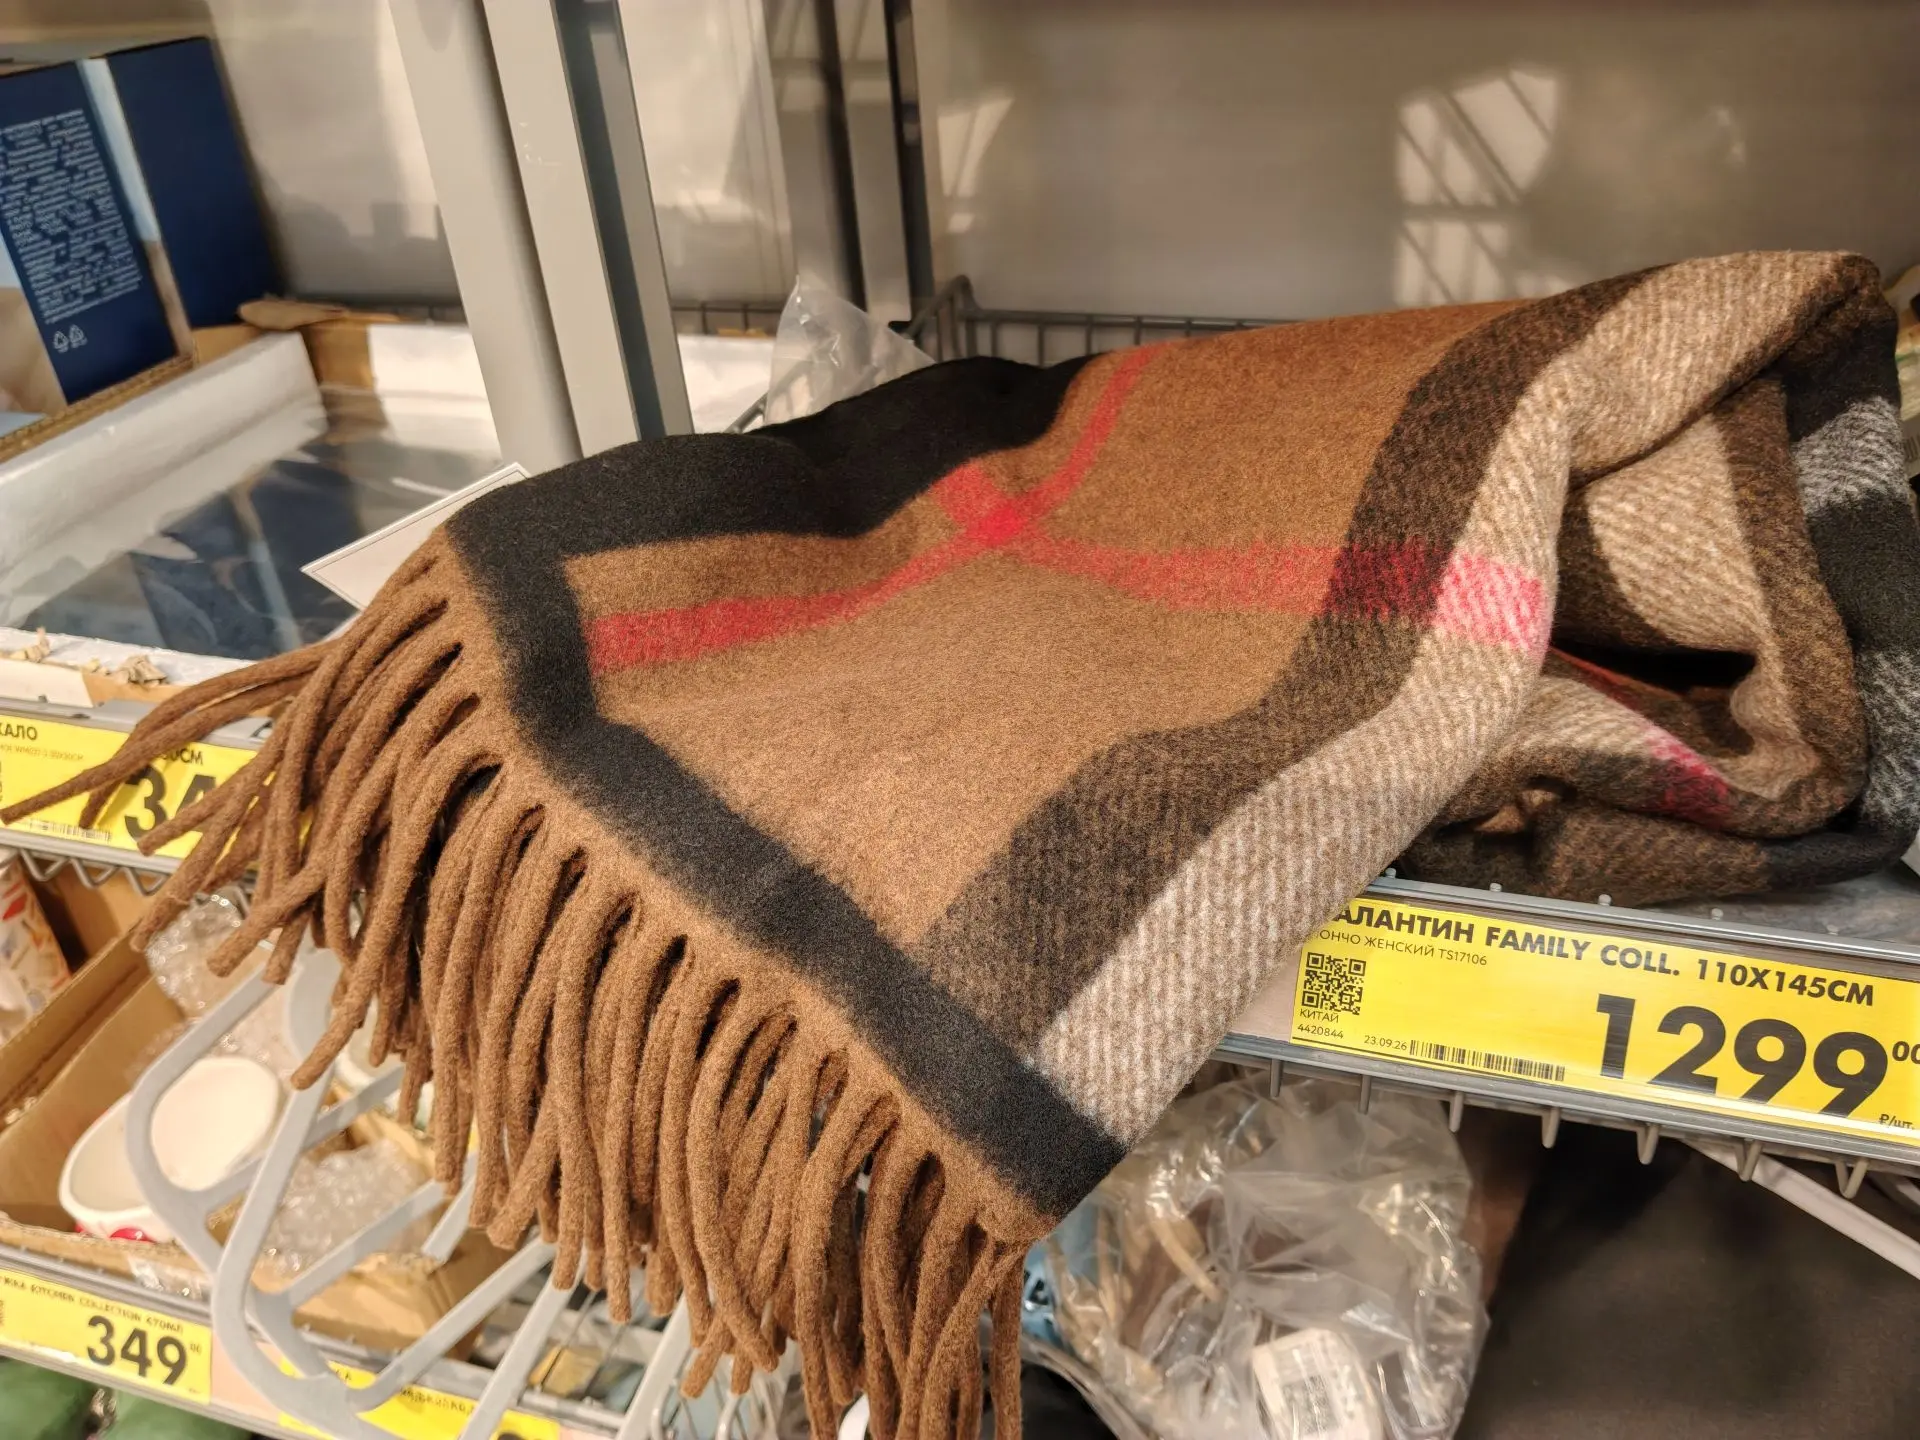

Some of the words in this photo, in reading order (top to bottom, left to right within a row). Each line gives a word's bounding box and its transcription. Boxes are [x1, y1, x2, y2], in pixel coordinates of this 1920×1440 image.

[1316, 929, 1361, 945] ОНЧО
[1364, 936, 1434, 957] ЖЕНСКИЙ
[1438, 948, 1487, 966] TS17106
[1485, 926, 1591, 960] FAMILY
[1600, 945, 1680, 976] COLL.
[1298, 1023, 1344, 1039] 4420844
[1300, 1008, 1339, 1024] КИТАЙ
[1364, 1035, 1407, 1051] 23.09.26
[1597, 994, 1888, 1118] 1299
[87, 1315, 188, 1386] 349
